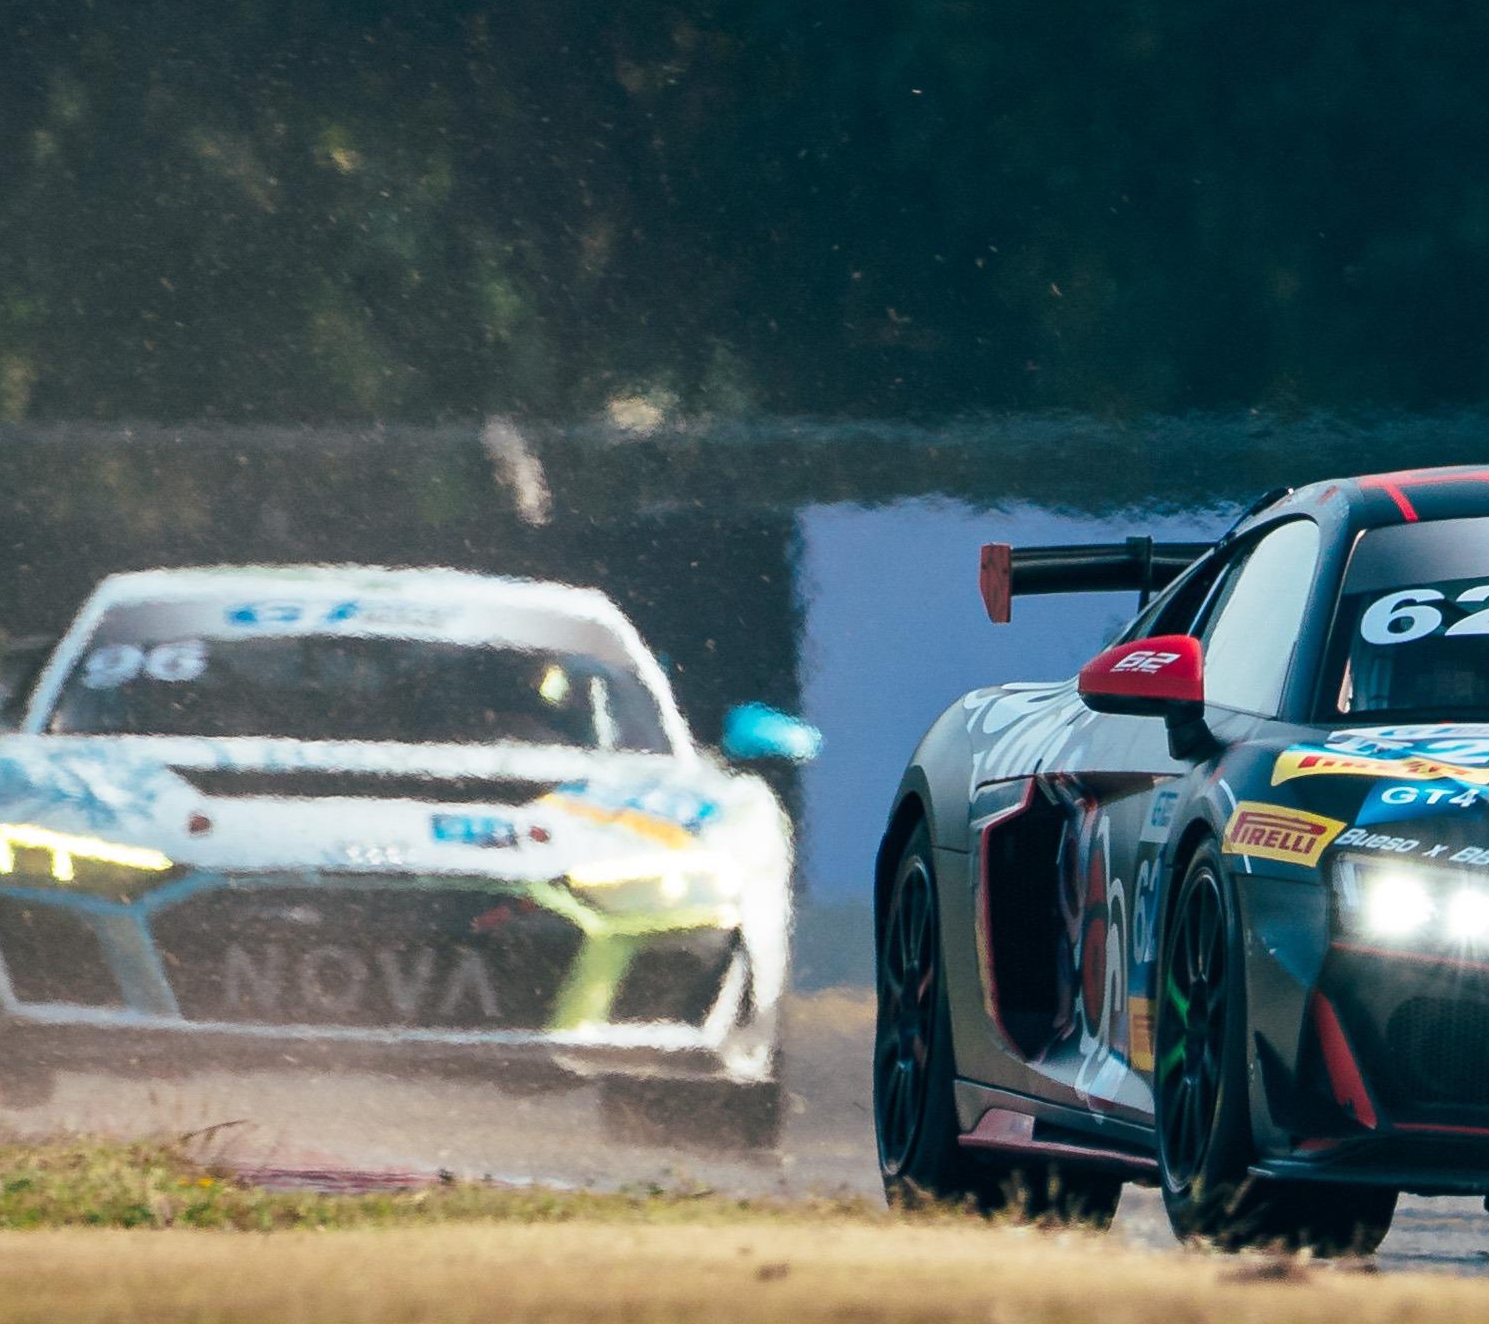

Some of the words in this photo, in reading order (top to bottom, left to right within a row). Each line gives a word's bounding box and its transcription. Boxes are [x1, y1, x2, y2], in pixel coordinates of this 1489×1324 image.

[1113, 650, 1182, 672] 62
[1381, 786, 1481, 808] GT4
[1229, 809, 1328, 855] PIRELLI
[1334, 828, 1419, 853] Bueso
[1422, 844, 1449, 858] x
[224, 944, 503, 1017] NOVA
